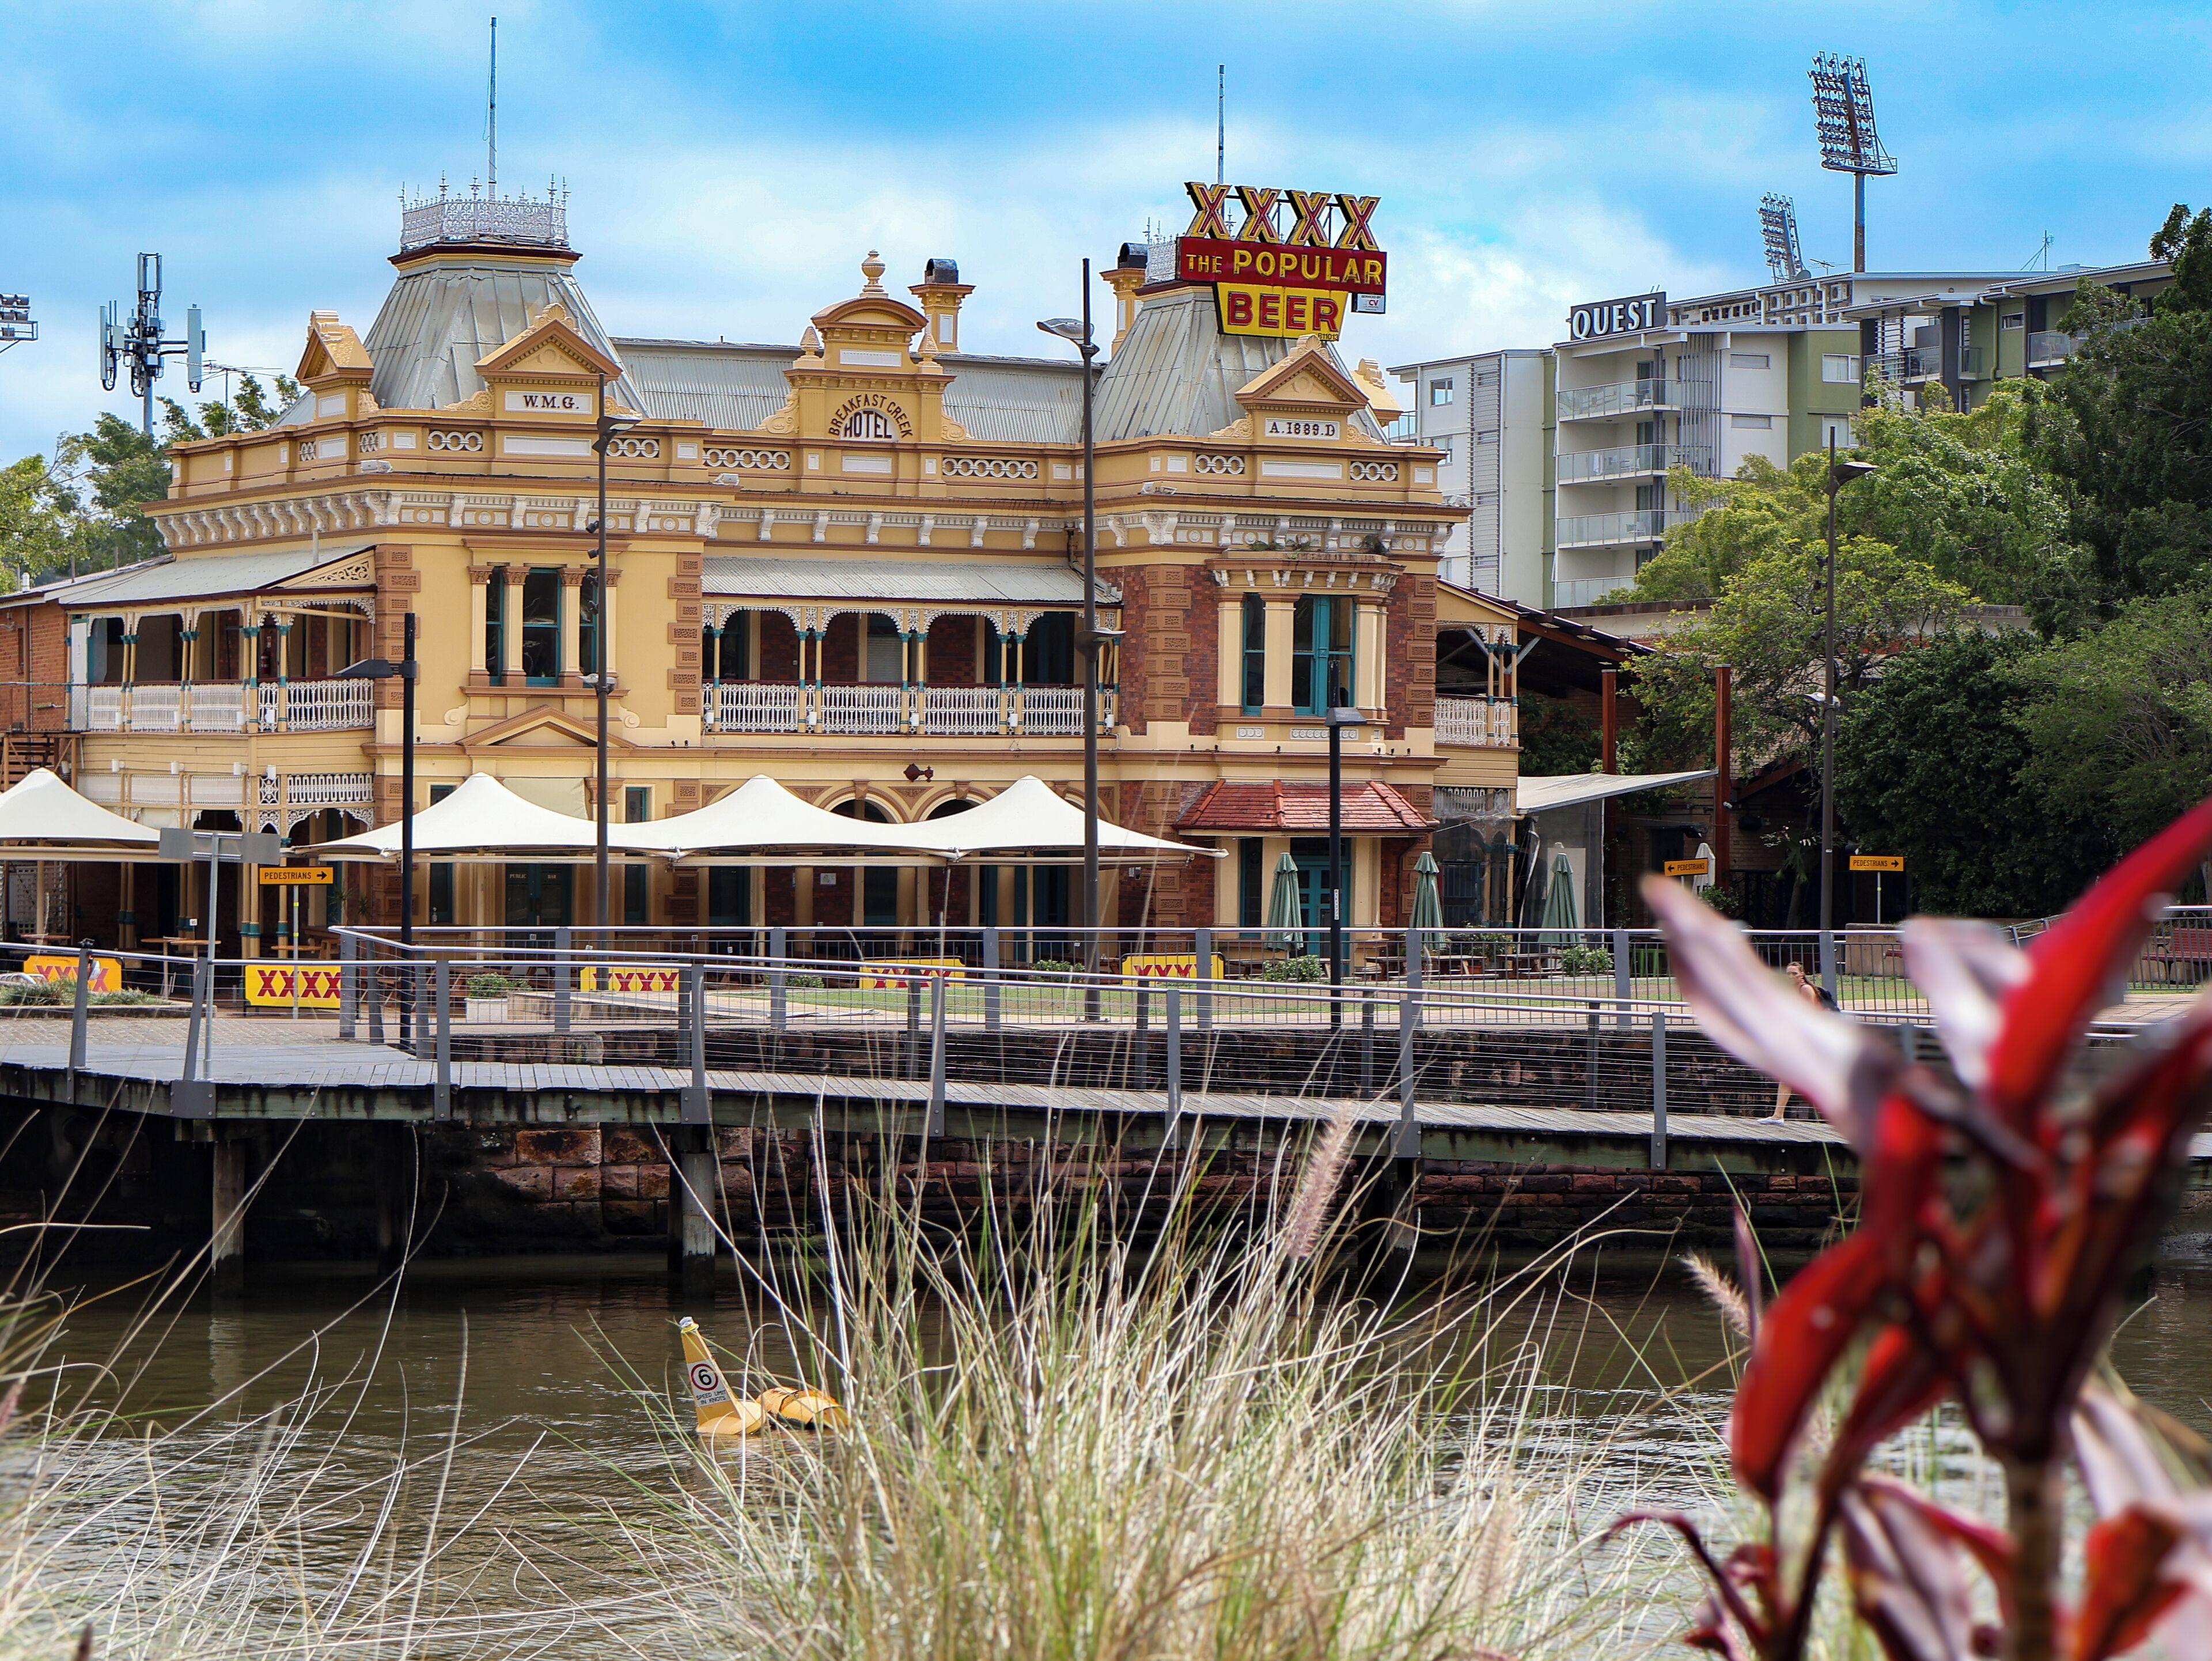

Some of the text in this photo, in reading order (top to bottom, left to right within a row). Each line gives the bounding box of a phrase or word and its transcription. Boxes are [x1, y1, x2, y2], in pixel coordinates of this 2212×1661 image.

[1184, 182, 1381, 251] XXXX
[1185, 249, 1382, 285] THE POPULAR
[1228, 291, 1338, 332] BEER
[1572, 299, 1656, 339] QUEST
[828, 394, 913, 438] BREAKFAST CREEK
[843, 410, 892, 438] HOTEL
[257, 970, 341, 998] XXXX
[593, 973, 679, 991] XXX
[698, 1369, 712, 1386] 6
